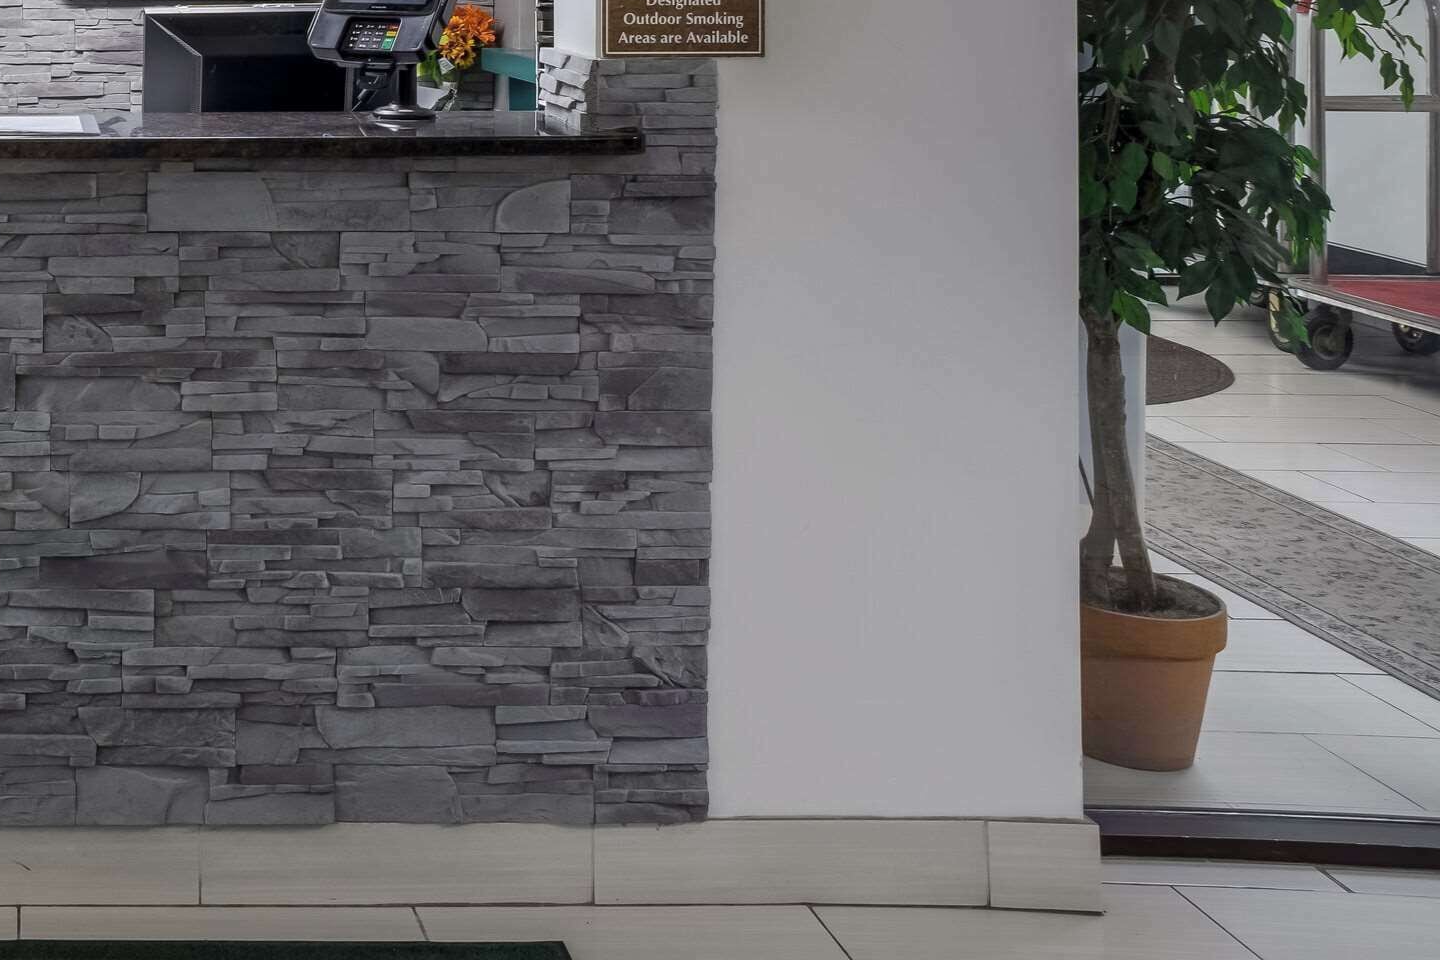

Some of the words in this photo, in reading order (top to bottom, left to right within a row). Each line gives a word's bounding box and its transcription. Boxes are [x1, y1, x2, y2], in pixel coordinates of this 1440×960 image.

[623, 12, 682, 25] Outdoor
[686, 12, 744, 29] Smoking
[618, 31, 656, 44] Areas
[660, 35, 682, 44] are
[686, 31, 749, 44] Available
